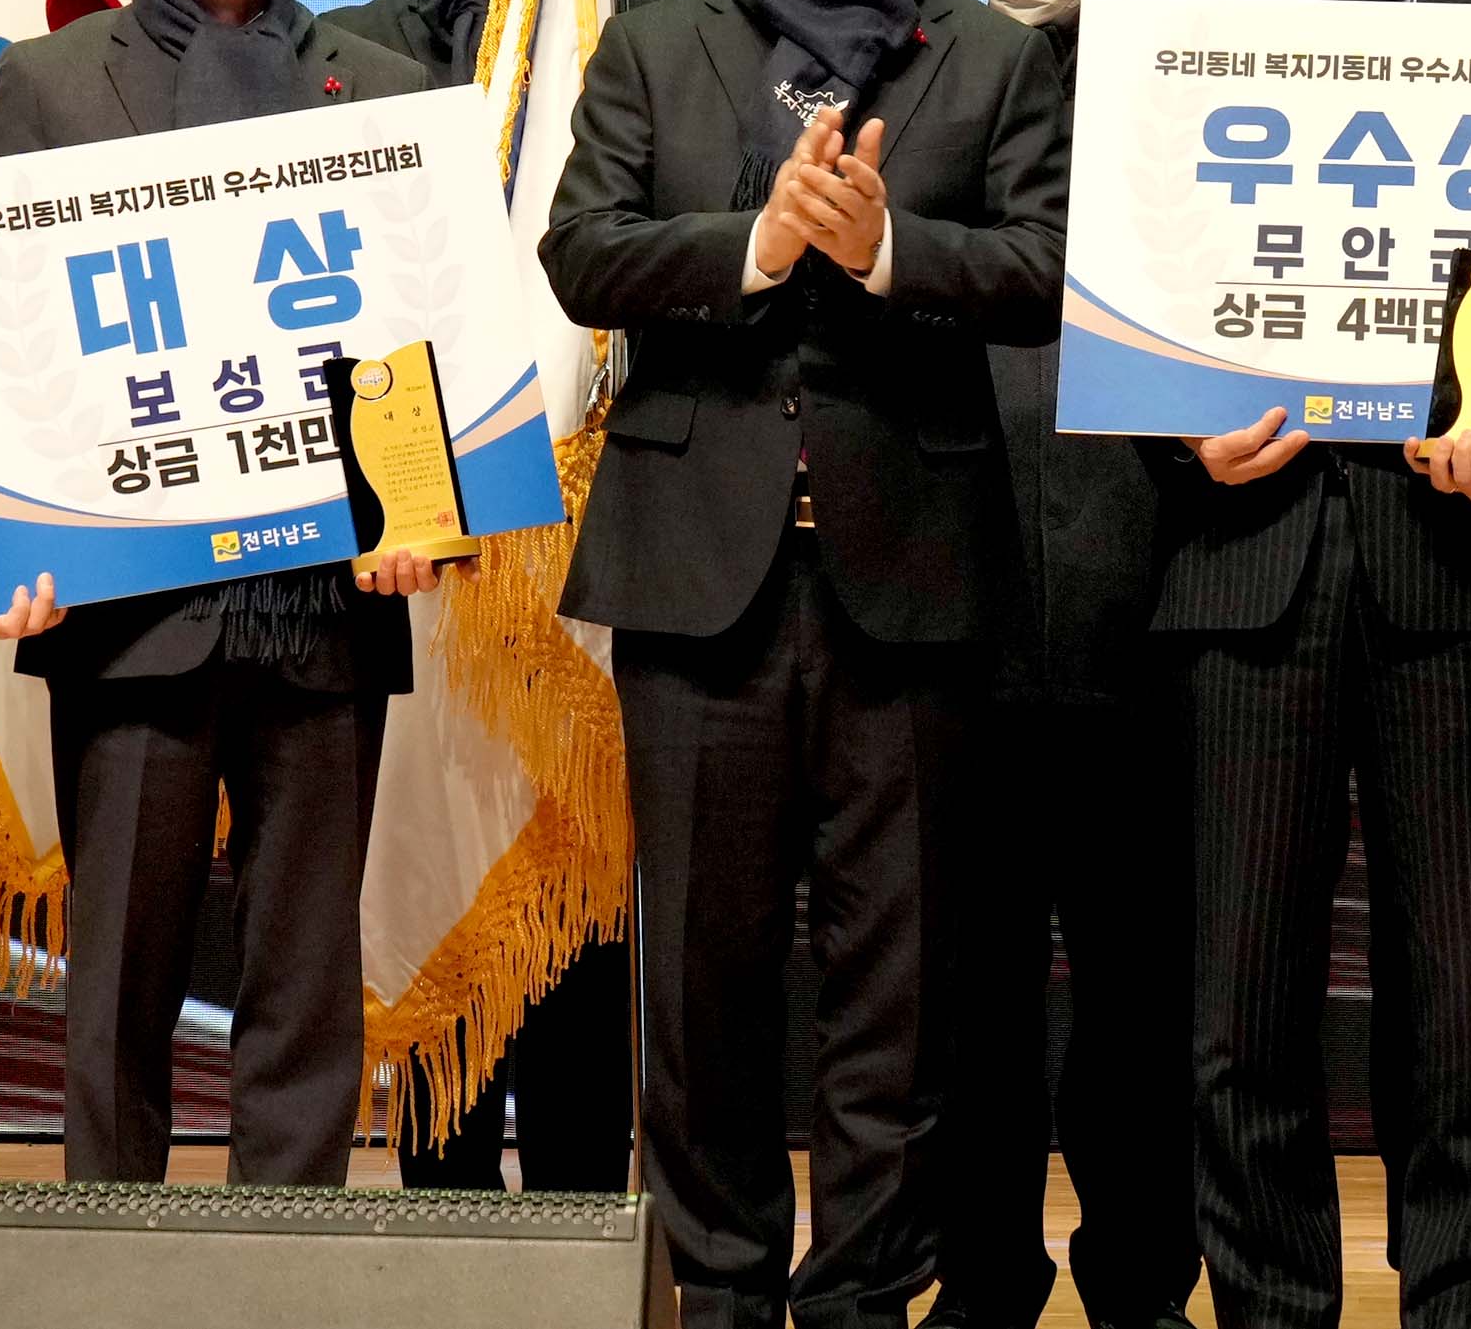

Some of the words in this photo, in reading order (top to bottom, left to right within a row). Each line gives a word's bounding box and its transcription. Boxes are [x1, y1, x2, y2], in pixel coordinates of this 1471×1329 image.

[1154, 50, 1256, 78] 우리동네
[1264, 52, 1392, 82] 복지기동대
[89, 175, 216, 217] 복지기동대
[223, 142, 423, 199] 우수사례경진대회
[65, 209, 363, 356] 대상
[1213, 292, 1307, 340] 상금
[125, 341, 344, 429] 보성군
[1335, 399, 1416, 422] 전라남도
[106, 437, 200, 495] 상금
[242, 521, 321, 552] 전라남도
